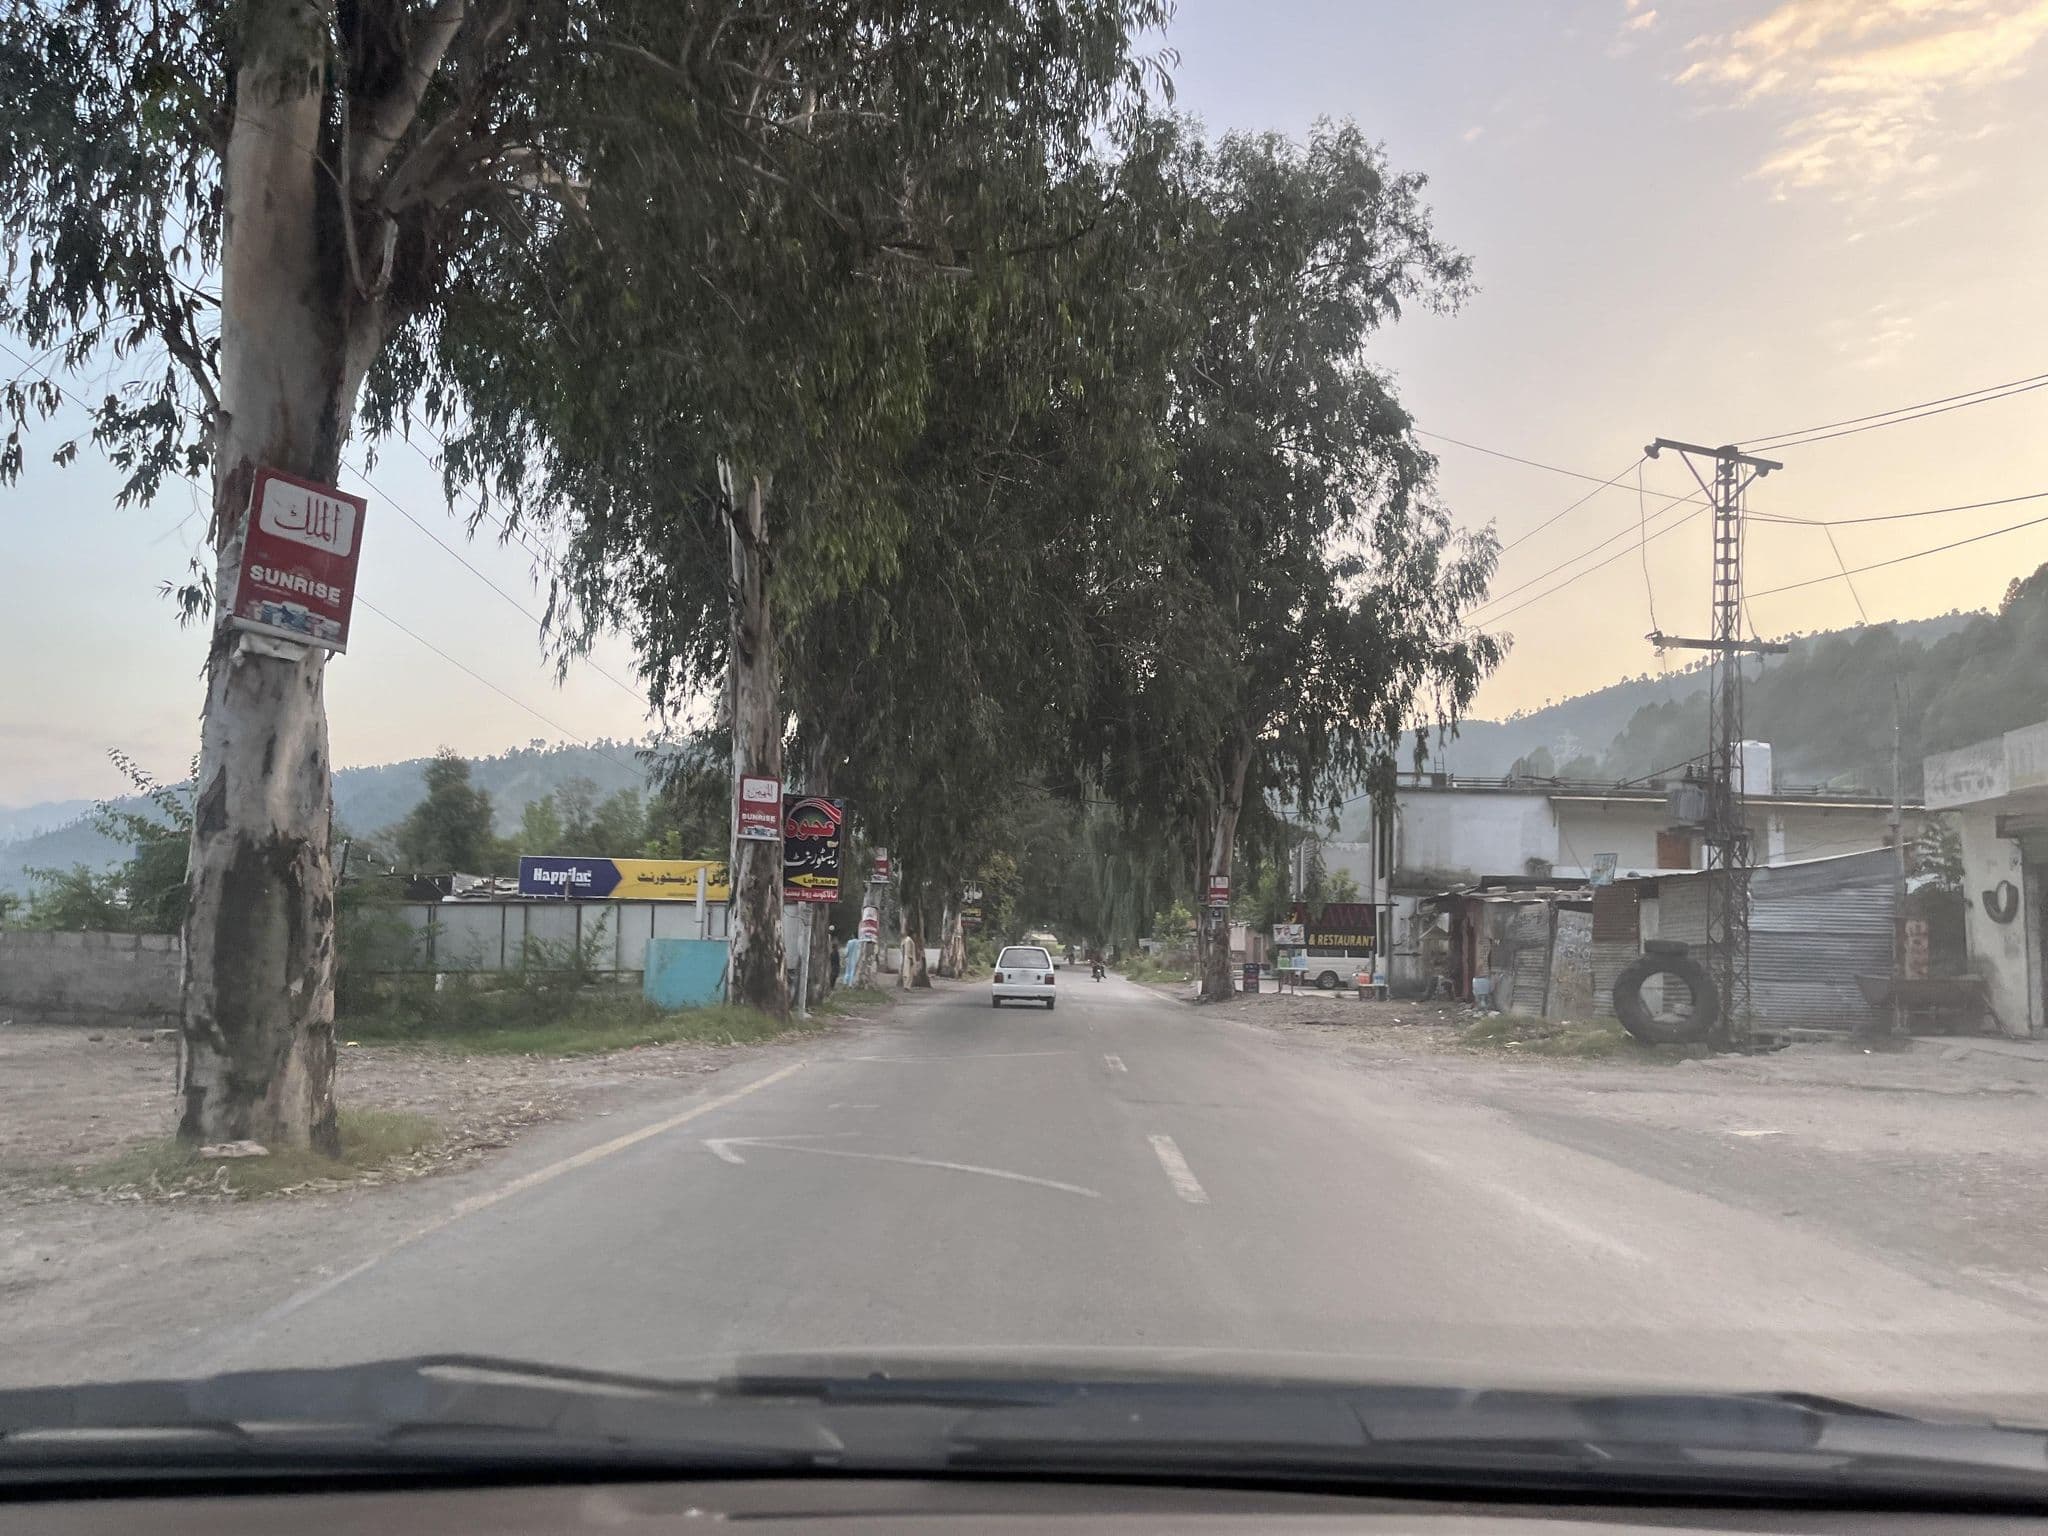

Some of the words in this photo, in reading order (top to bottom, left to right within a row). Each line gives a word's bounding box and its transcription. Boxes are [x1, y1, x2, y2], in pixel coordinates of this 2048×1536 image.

[249, 564, 341, 604] SUNRISE
[741, 813, 777, 823] SUNRISE
[533, 867, 592, 885] Happilac
[1308, 933, 1316, 945] &
[1317, 934, 1376, 947] RESTAURANT
